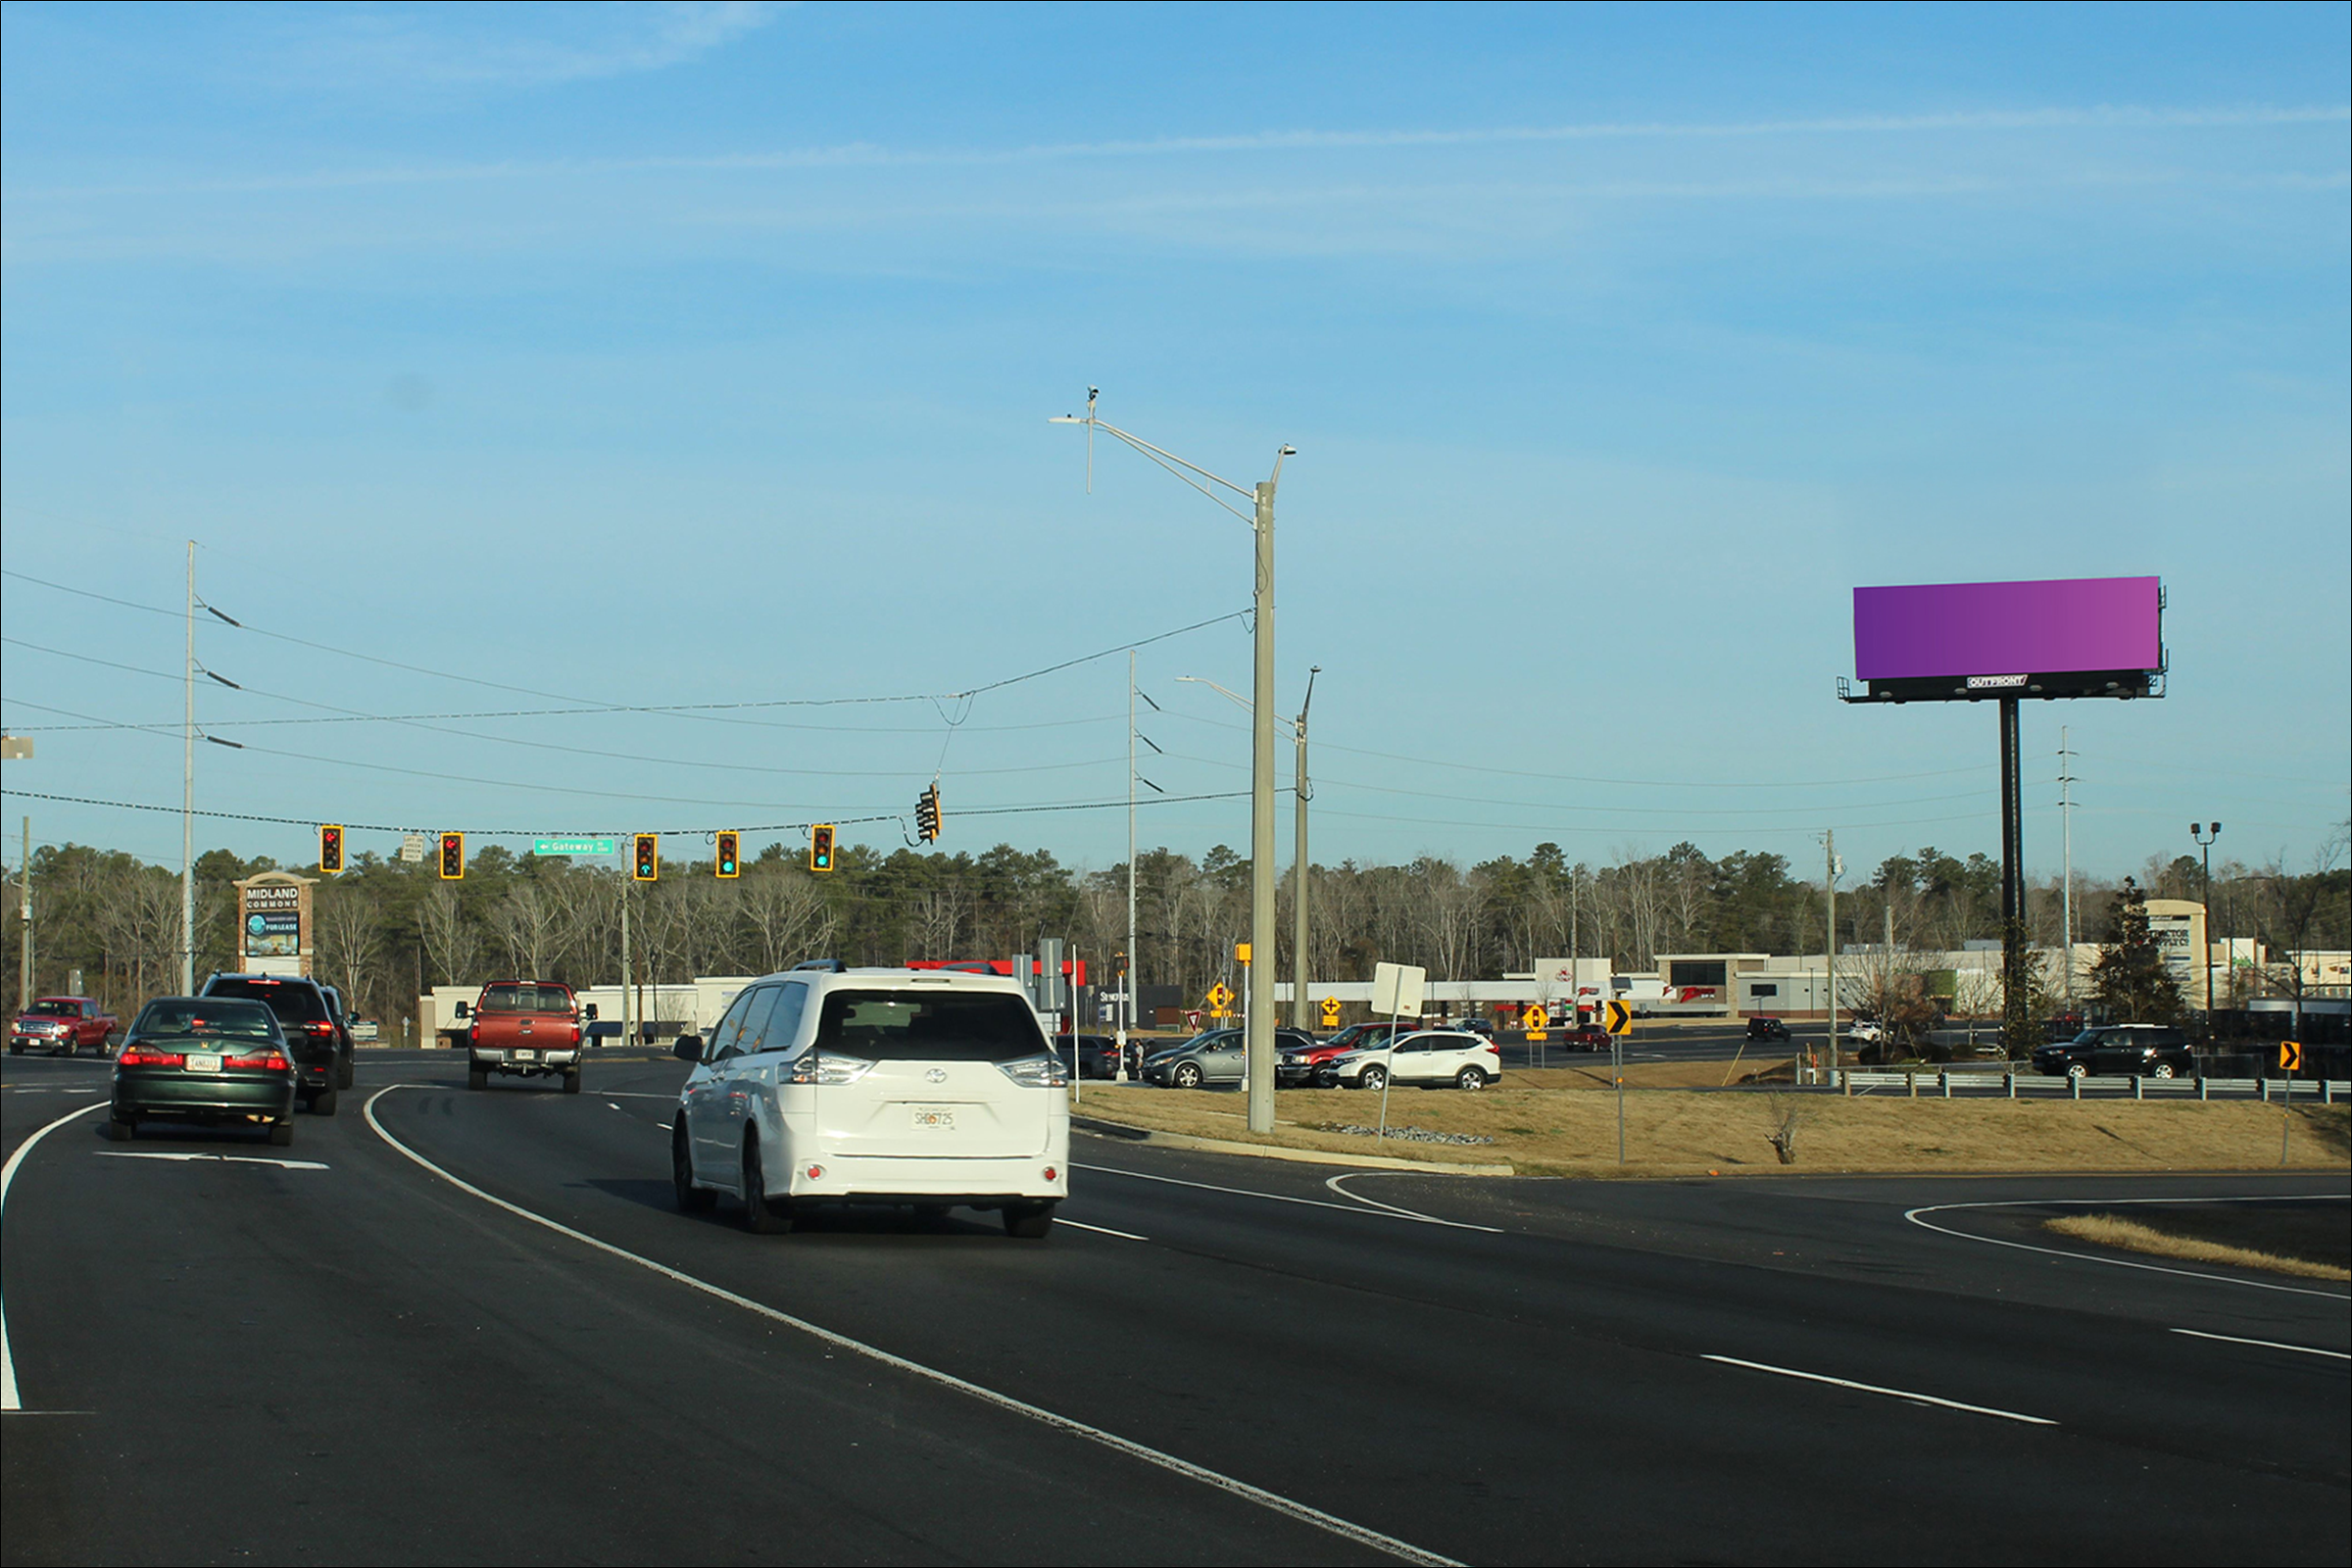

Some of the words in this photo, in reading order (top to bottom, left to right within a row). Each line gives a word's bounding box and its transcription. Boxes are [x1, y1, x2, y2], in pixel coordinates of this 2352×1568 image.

[1969, 675, 2025, 687] OUTFRONT
[552, 842, 594, 852] Gateway
[247, 888, 298, 900] MIDLAND
[247, 900, 298, 908] COMMONS
[1100, 991, 1130, 1003] SYNOUS
